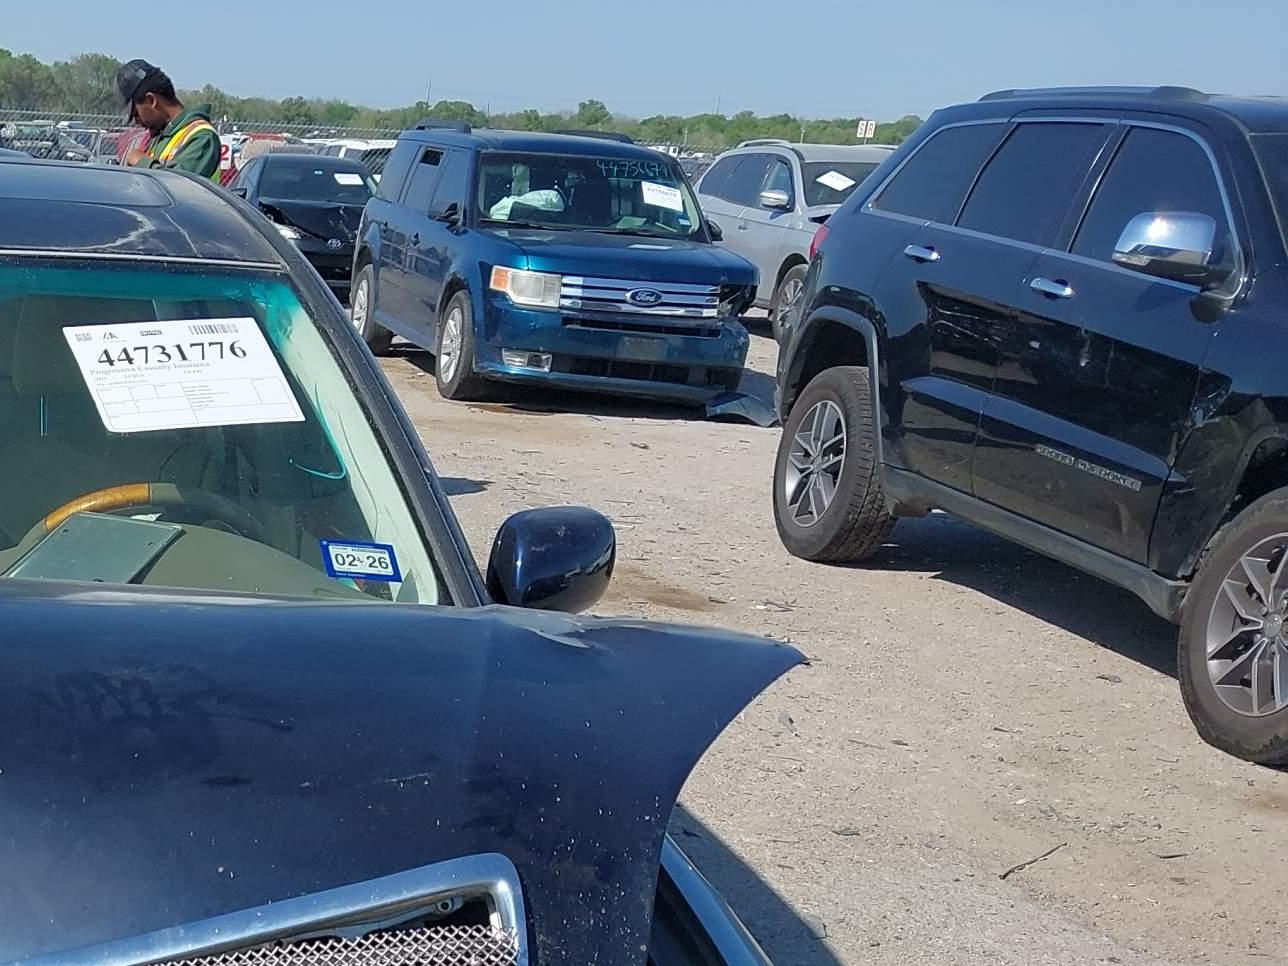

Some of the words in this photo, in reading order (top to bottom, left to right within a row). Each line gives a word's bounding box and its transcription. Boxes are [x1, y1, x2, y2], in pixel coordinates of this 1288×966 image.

[635, 291, 657, 302] Ford
[97, 339, 248, 367] 44731776
[89, 366, 136, 376] Progressive
[137, 363, 172, 372] Casualty
